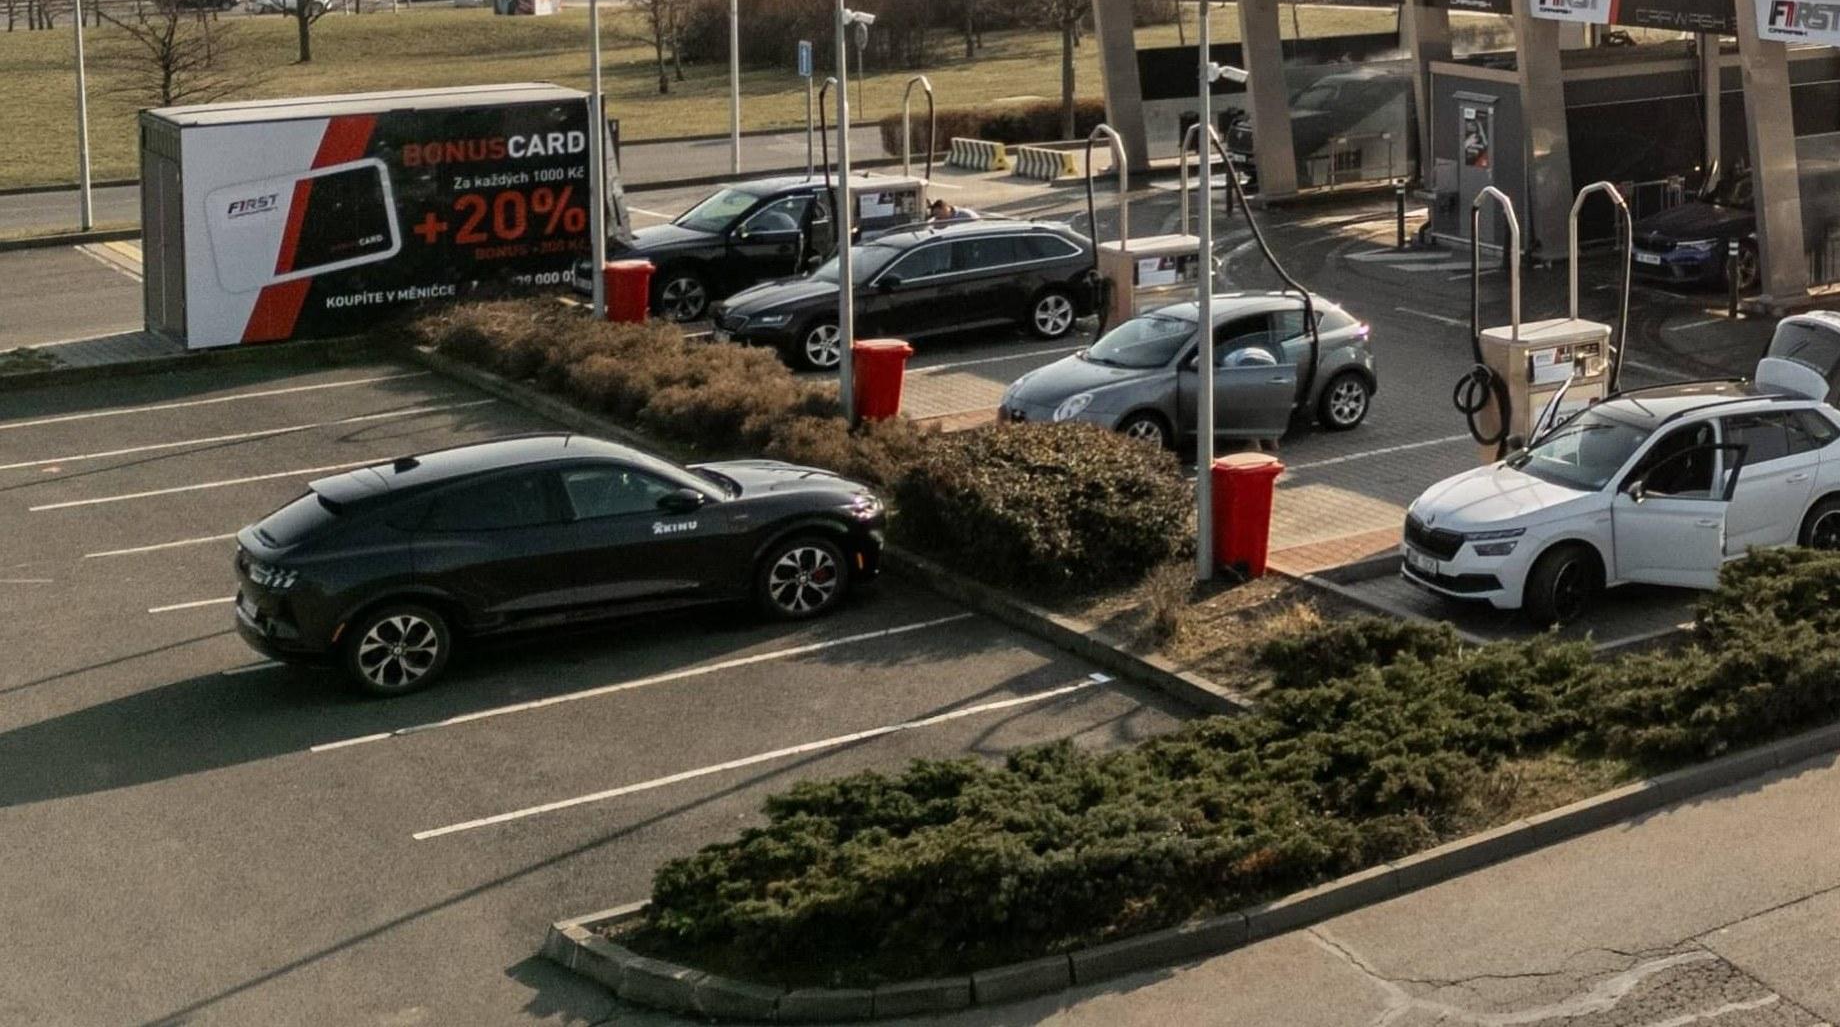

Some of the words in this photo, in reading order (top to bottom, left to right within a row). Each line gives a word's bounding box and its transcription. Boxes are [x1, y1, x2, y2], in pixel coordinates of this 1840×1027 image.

[1634, 8, 1727, 29] CARWASH
[453, 177, 471, 190] Za
[475, 172, 529, 188] každých
[534, 168, 564, 182] 1000
[567, 166, 585, 179] Kč
[413, 185, 586, 245] +20%
[326, 291, 384, 309] KOUPÍTE
[387, 290, 394, 301] V
[397, 283, 456, 301] MĚNIČCE
